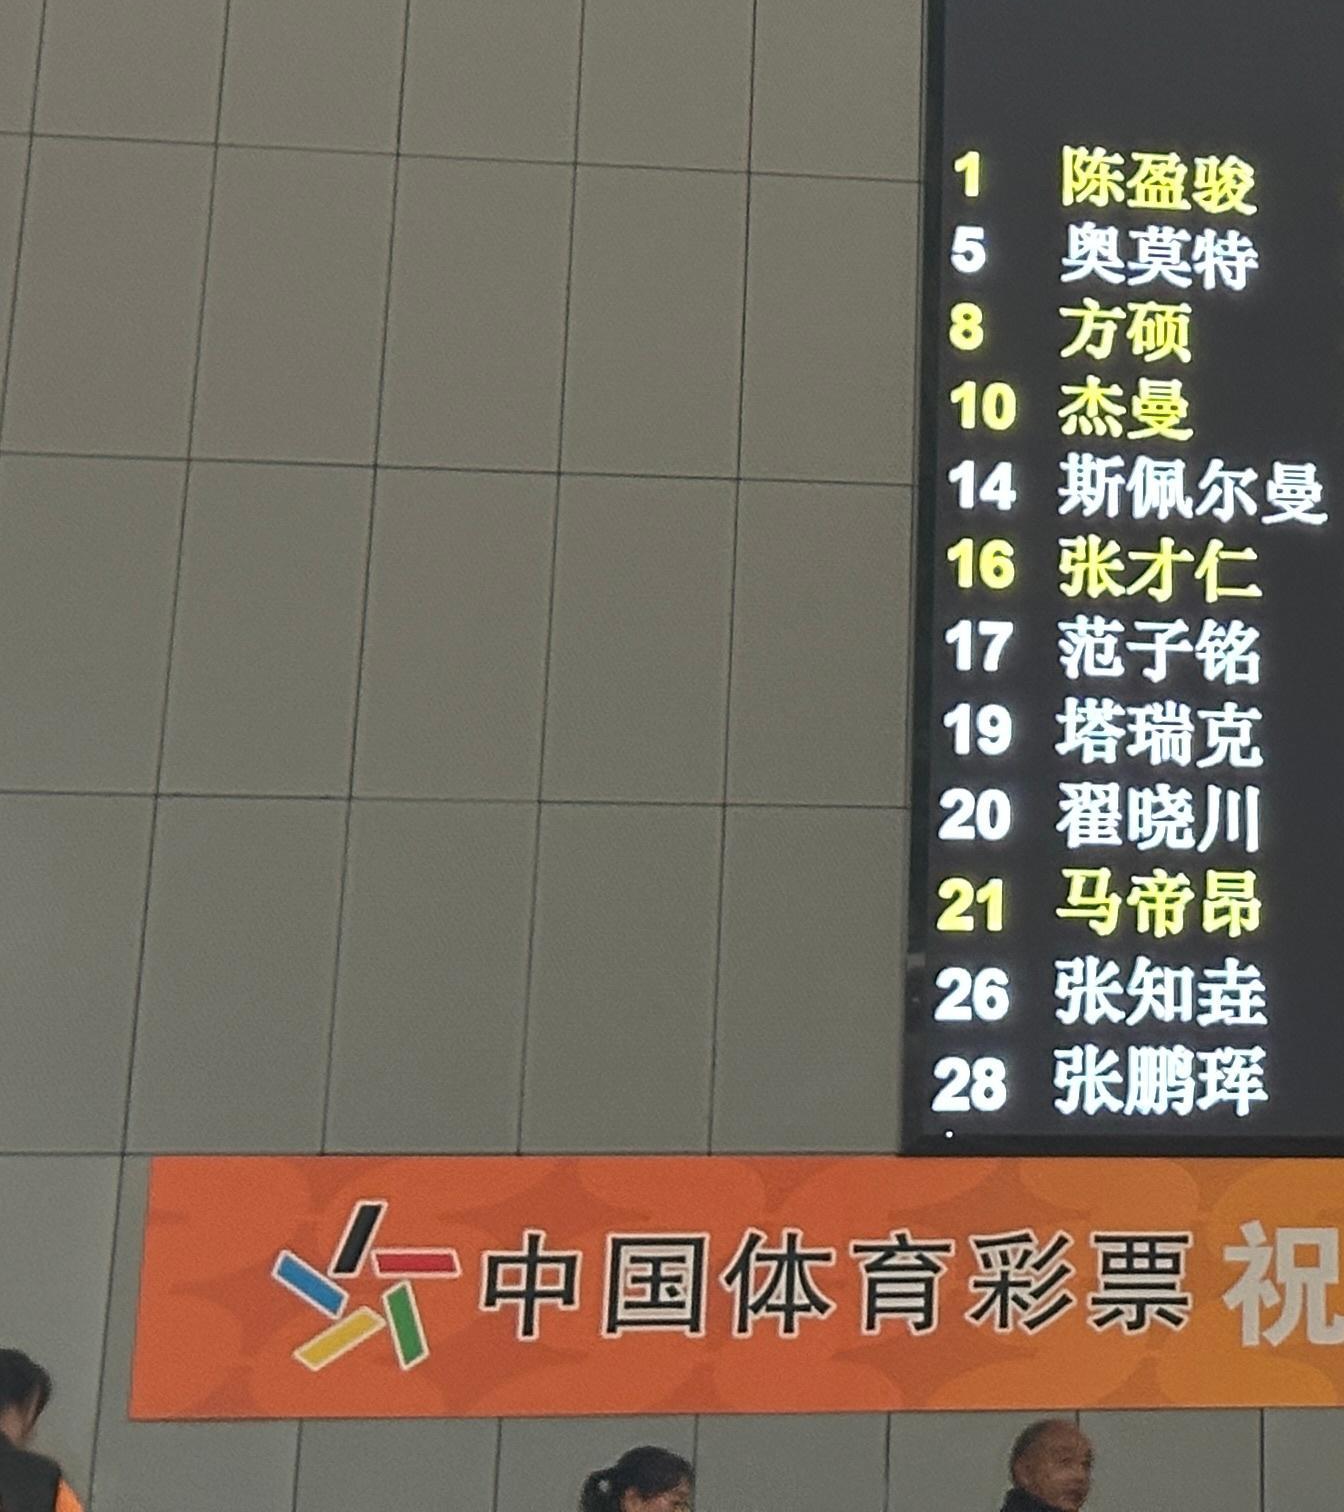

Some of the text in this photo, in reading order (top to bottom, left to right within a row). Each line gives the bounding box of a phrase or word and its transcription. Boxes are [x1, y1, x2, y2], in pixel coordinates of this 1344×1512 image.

[955, 151, 982, 197] 1
[1062, 145, 1257, 216] 陈盈骏
[951, 226, 988, 274] 5
[1061, 221, 1259, 291] 奥莫特
[949, 303, 984, 350] 8
[1059, 297, 1192, 363] 方硕
[951, 381, 1016, 430] 10
[1058, 375, 1193, 441] 杰曼
[949, 460, 1017, 511] 14
[1058, 452, 1328, 525] 斯佩尔曼
[948, 538, 1015, 589] 16
[1059, 534, 1262, 603] 张才仁
[945, 620, 1013, 672] 17
[1058, 614, 1260, 685] 范子铭
[944, 703, 1015, 755] 19
[1055, 697, 1263, 768] 塔瑞克
[939, 788, 1014, 841] 20
[1056, 782, 1260, 852] 翟晓川
[937, 878, 1005, 931] 21
[1056, 867, 1262, 938] 马帝昂
[935, 967, 1012, 1022] 26
[932, 1057, 1009, 1112] 28
[1054, 1044, 1268, 1116] 张鹏珲
[478, 1228, 1197, 1341] 中国体育彩票
